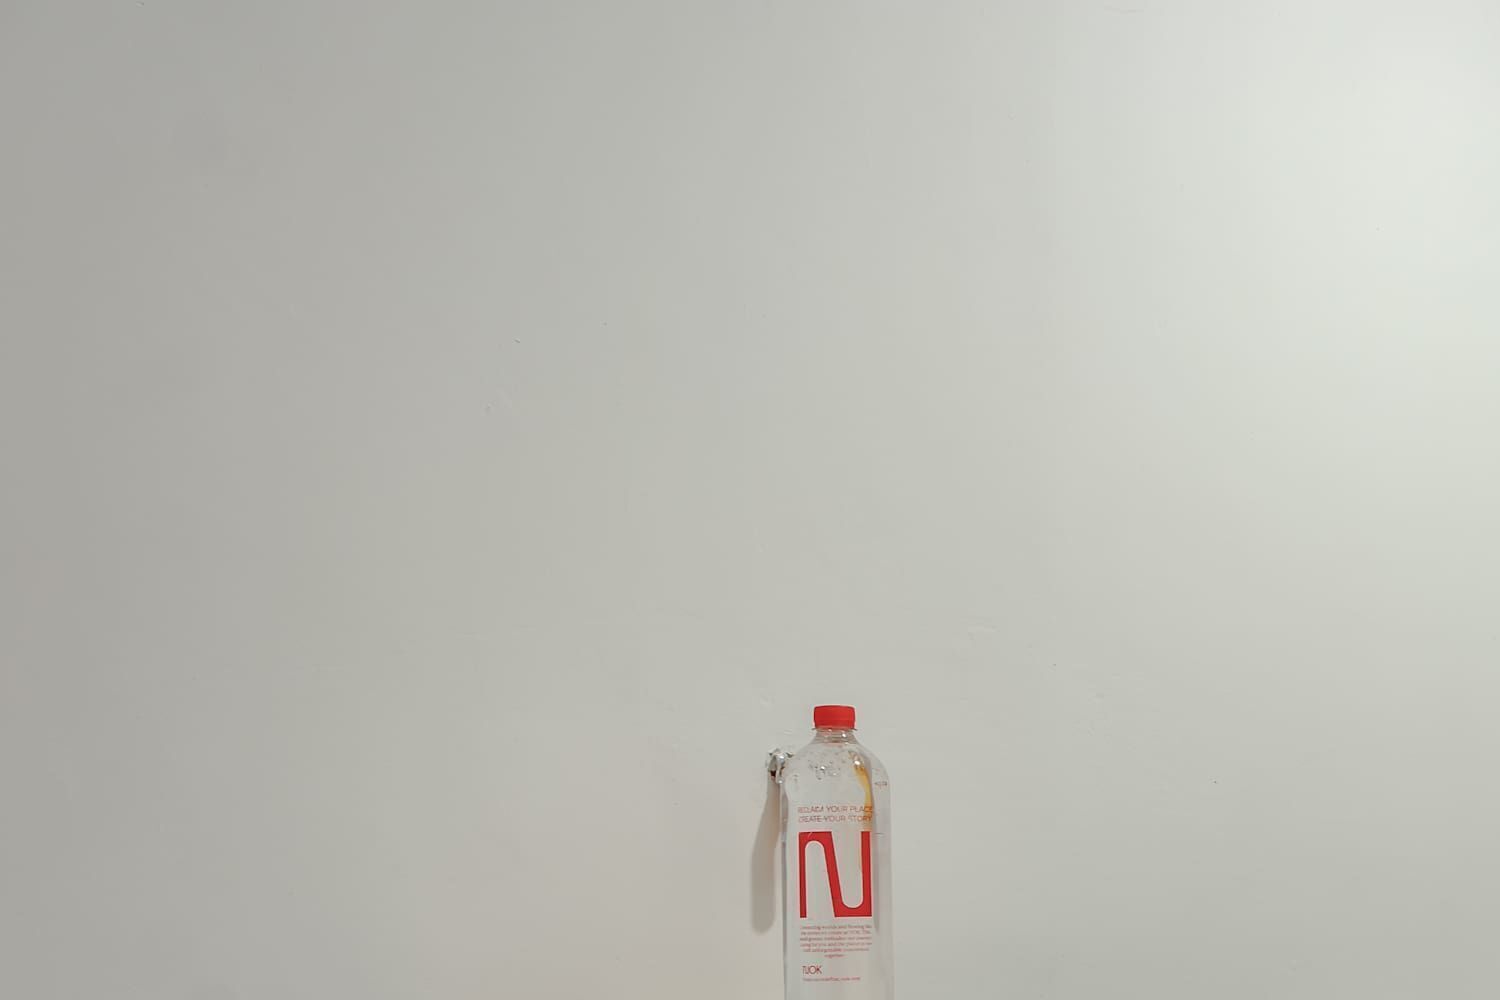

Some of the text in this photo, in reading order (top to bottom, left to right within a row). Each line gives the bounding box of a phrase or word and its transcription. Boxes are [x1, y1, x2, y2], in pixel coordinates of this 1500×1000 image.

[826, 805, 848, 813] YOUR
[849, 805, 873, 813] PLACE
[823, 815, 846, 823] YOUR
